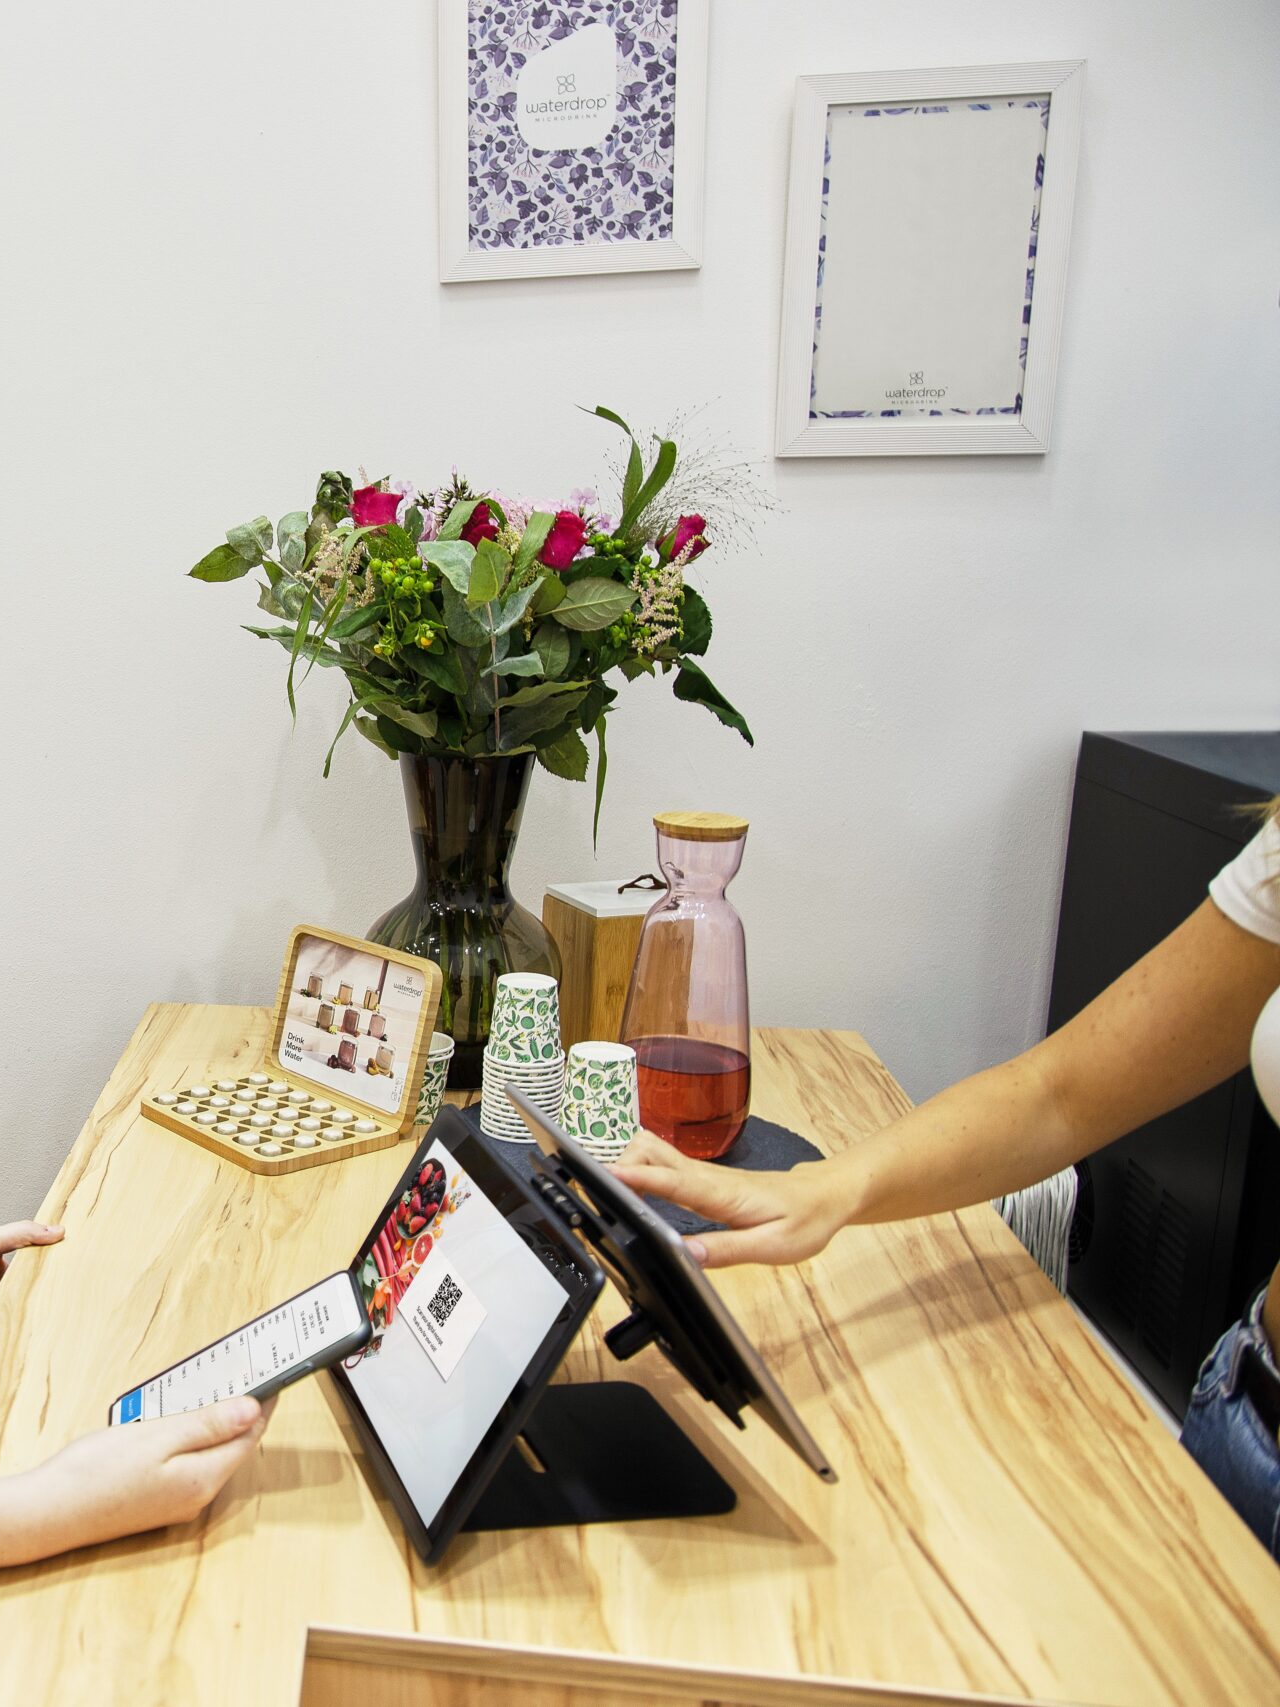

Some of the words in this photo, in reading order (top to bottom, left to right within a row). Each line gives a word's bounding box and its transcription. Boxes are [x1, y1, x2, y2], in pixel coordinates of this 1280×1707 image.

[526, 97, 607, 113] waterdrop
[885, 387, 945, 398] waterdrop
[287, 1031, 305, 1044] Drink
[285, 1041, 302, 1052] More
[284, 1049, 303, 1062] Water
